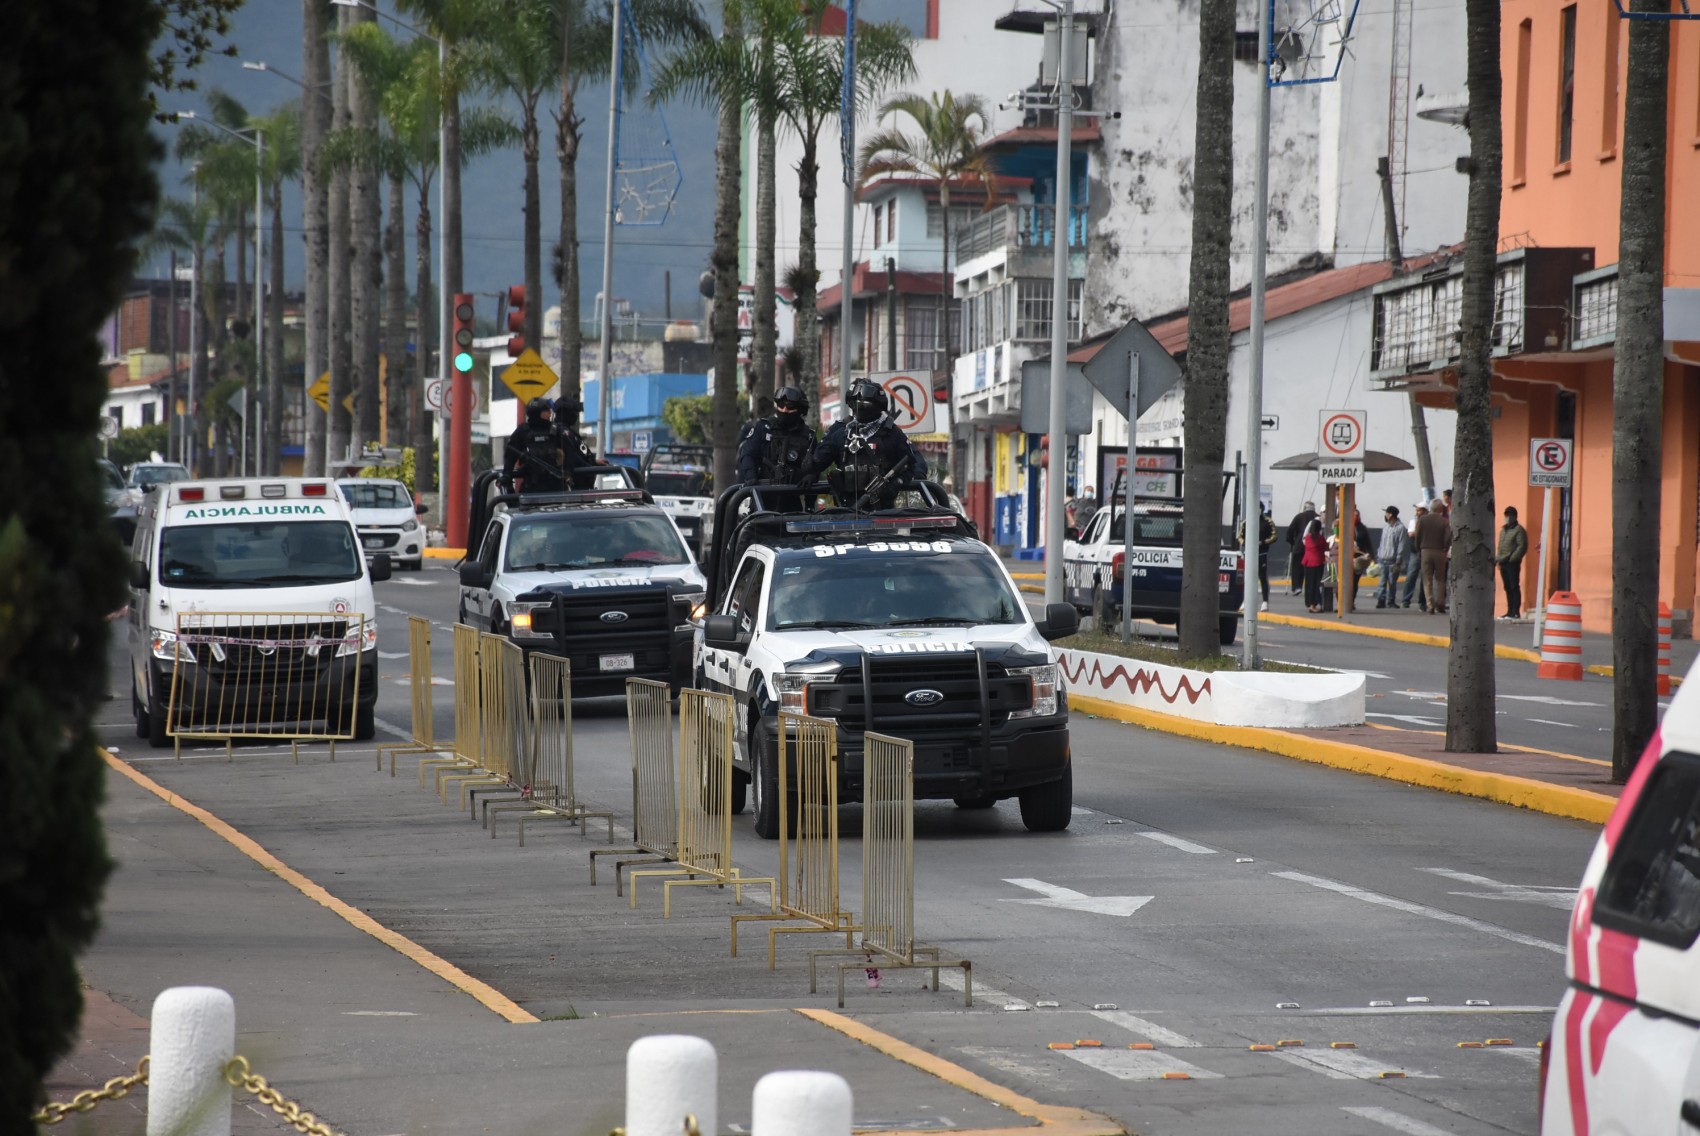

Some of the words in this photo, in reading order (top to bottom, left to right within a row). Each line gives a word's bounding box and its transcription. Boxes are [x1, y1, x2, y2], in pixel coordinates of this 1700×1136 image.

[1322, 468, 1360, 478] PARADA
[1538, 475, 1568, 483] ESTACIONARSE
[1146, 481, 1168, 492] CFE
[1132, 552, 1170, 564] POLICIA
[1219, 556, 1235, 568] TAL
[572, 578, 652, 590] POLICIA
[864, 642, 975, 653] POLICIA
